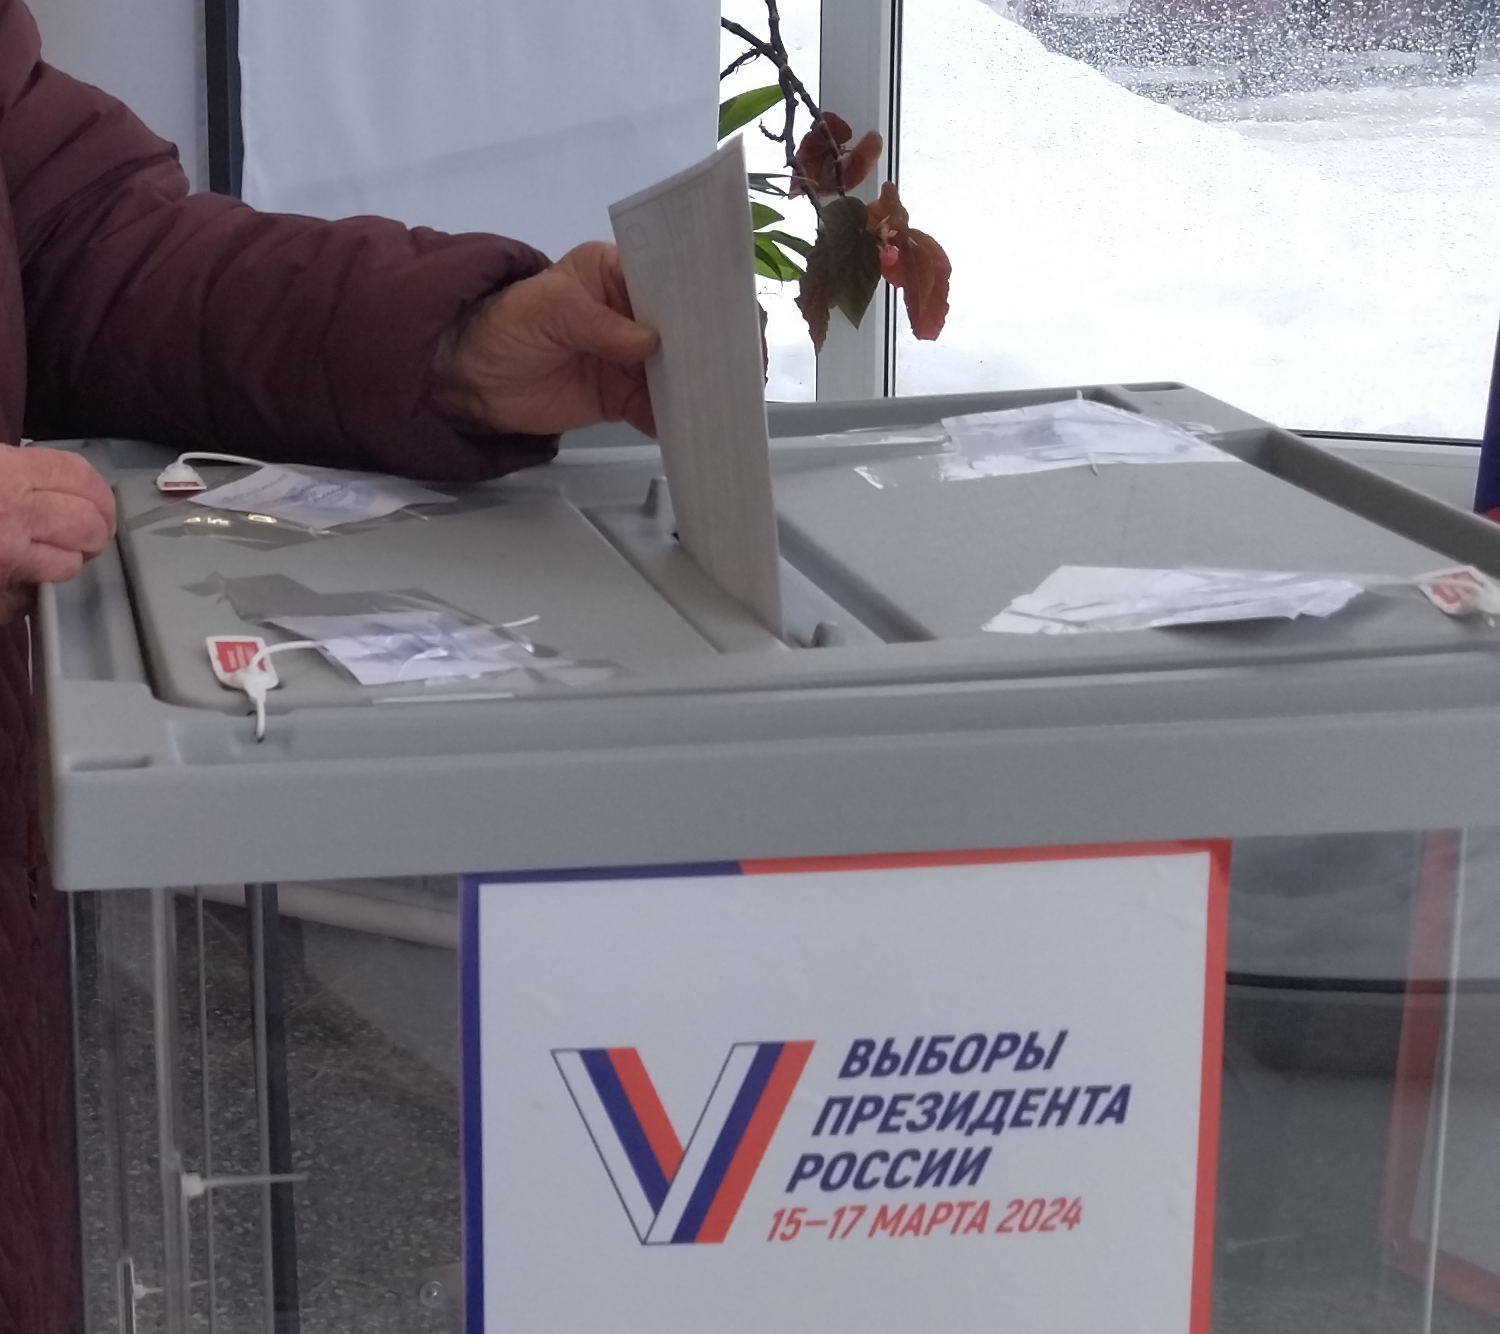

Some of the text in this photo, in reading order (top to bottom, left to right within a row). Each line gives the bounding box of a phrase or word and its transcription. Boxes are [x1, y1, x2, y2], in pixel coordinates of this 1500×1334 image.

[837, 1030, 1068, 1079] ВЫБОРЫ
[812, 1084, 1132, 1137] ПРЕЗИДЕНТА
[785, 1146, 993, 1193] РОССИИ
[868, 1200, 991, 1238] МАРТА
[996, 1197, 1083, 1232] 2024
